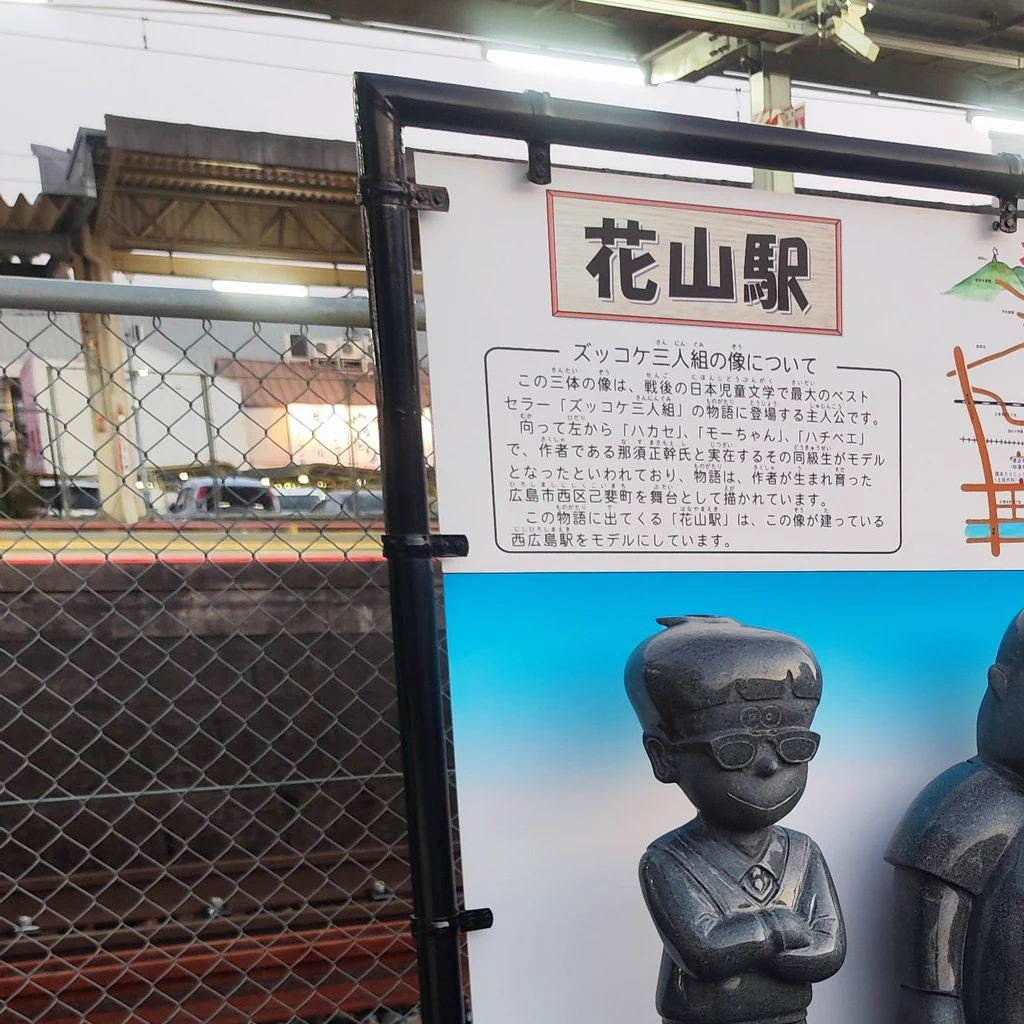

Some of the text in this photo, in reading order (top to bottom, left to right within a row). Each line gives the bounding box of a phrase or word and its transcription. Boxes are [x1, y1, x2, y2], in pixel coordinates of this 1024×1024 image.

[584, 217, 812, 314] 花山駅
[574, 342, 817, 375] ズッコケ三人組の像について
[518, 374, 869, 403] この三体の像は、戦後の日本児童文学で最大のベスト
[504, 396, 879, 426] セラー「ズッコケ三人組」の物語に登場する主人公です。
[506, 443, 886, 467] で、作者である那須正幹氏と実在するその同級生がモデル
[509, 466, 872, 487] となったといわれており、物語は、作者が生まれ育った
[509, 488, 827, 507] 広島市西区己斐町を舞台として描かれています。
[526, 511, 885, 528] この物語に出てくる「花山駅」は、この像が建っている
[511, 533, 731, 548] 西広島駅をモデルにしています。
